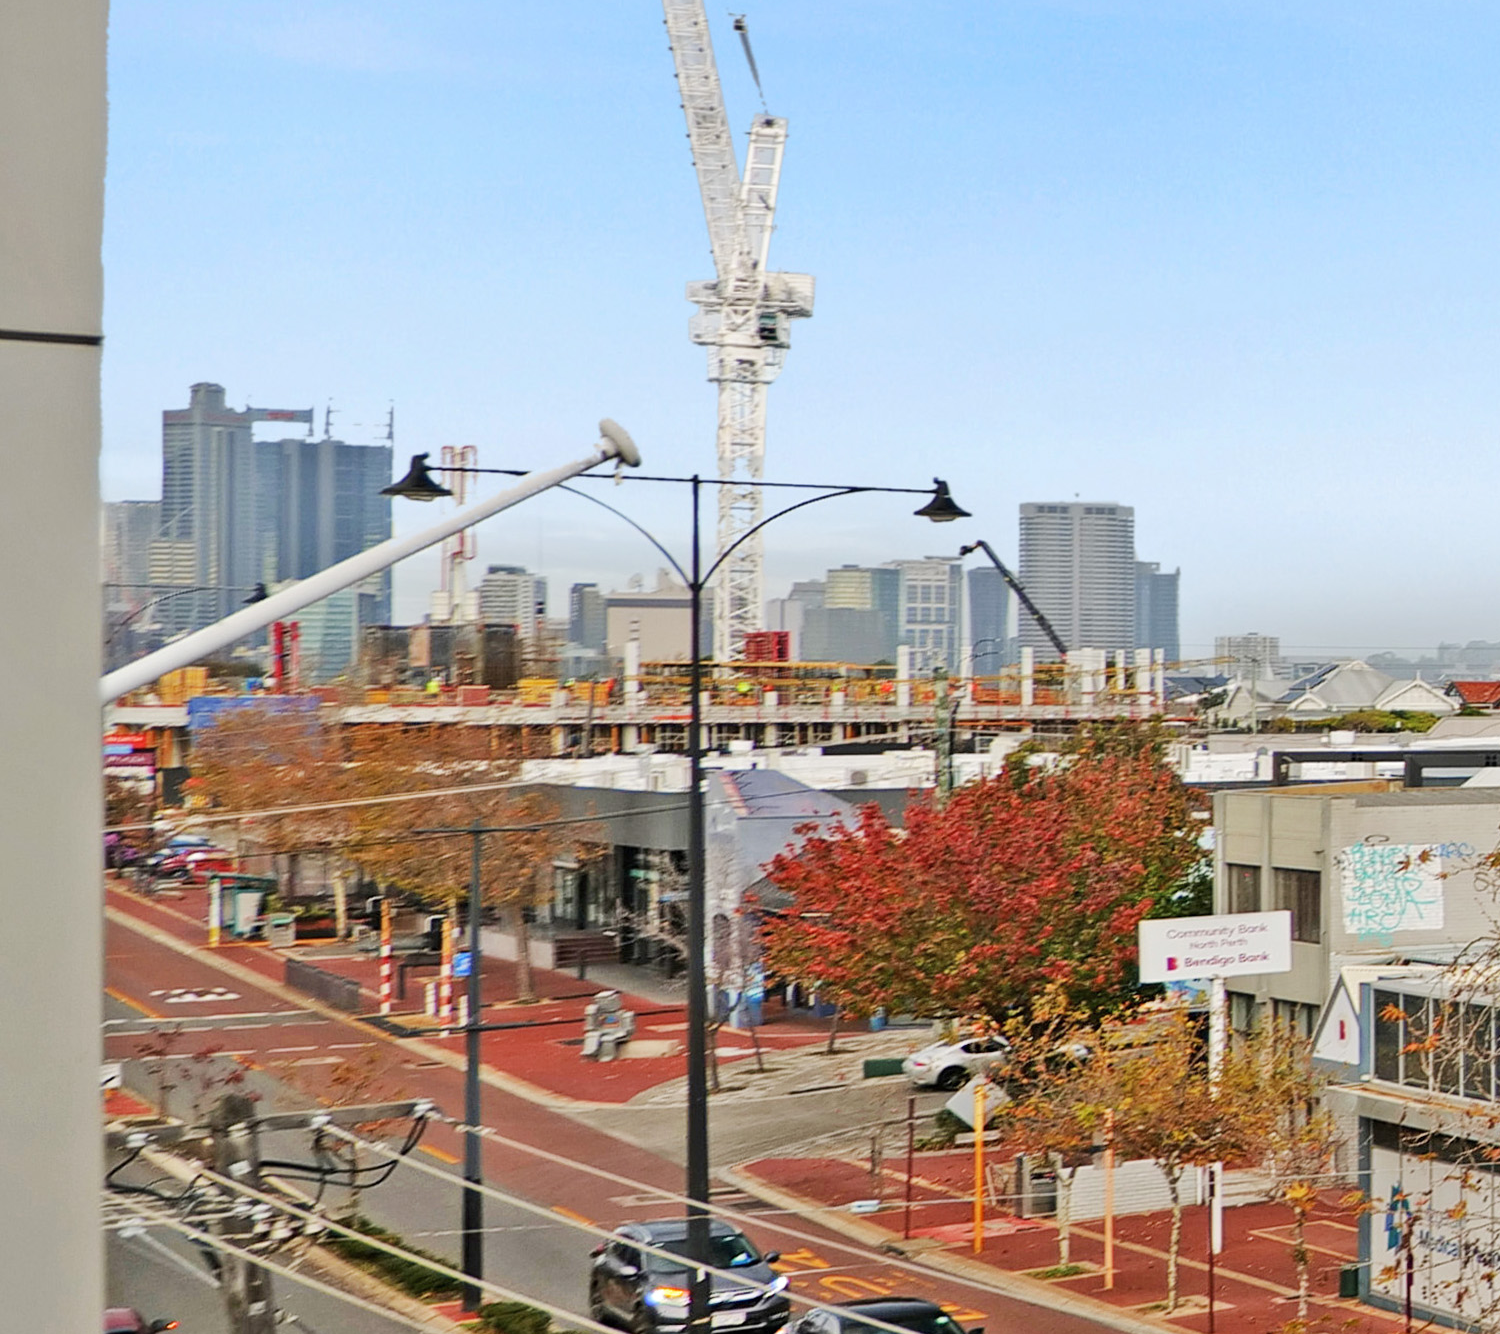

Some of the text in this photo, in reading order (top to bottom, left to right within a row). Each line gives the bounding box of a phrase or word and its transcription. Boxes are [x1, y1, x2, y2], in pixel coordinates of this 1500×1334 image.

[1166, 923, 1268, 939] Community Bank
[1184, 954, 1235, 968] Bendigo
[1238, 951, 1270, 964] Bank
